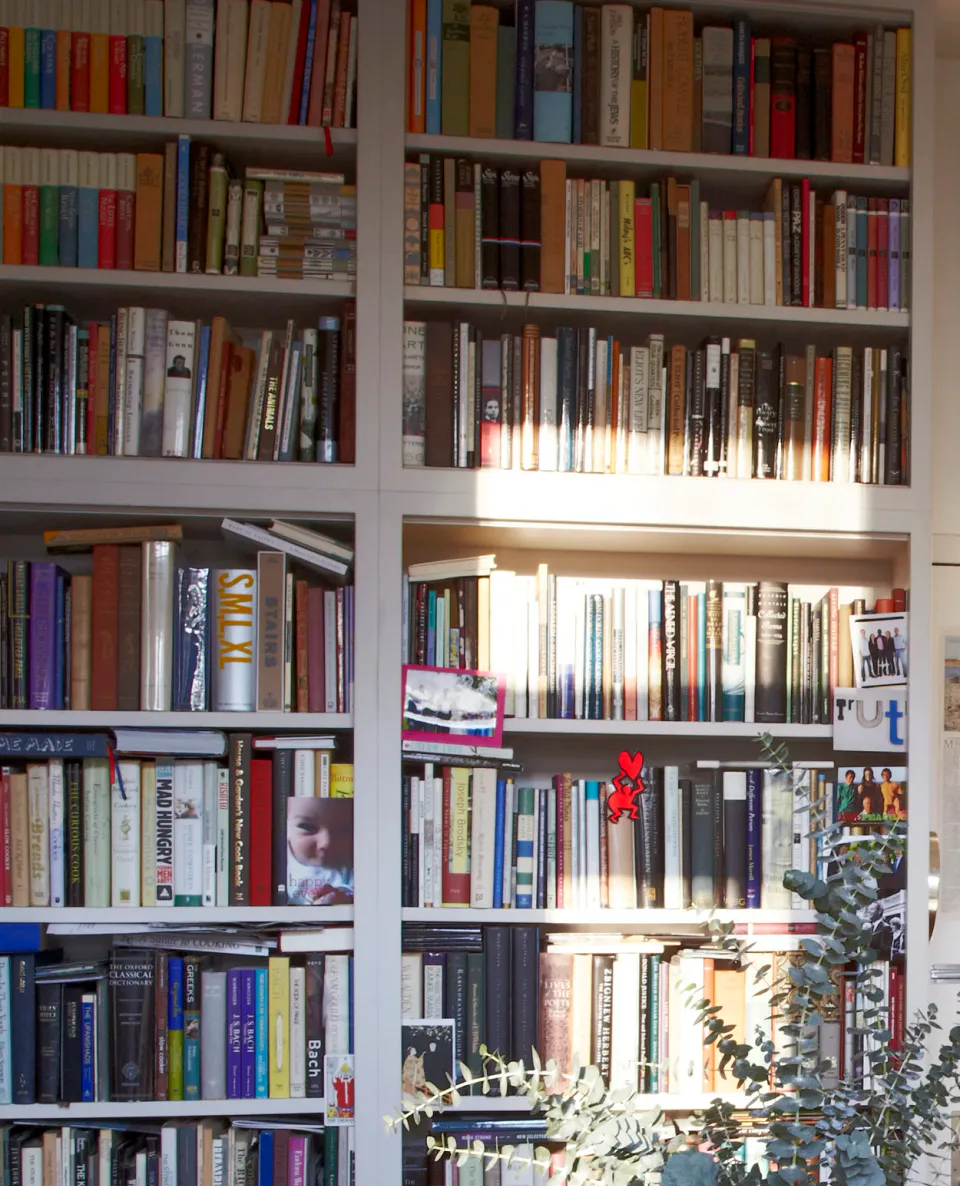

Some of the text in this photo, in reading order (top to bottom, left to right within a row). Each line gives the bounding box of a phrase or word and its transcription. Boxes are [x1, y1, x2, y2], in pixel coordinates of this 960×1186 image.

[191, 45, 207, 113] LERMAN
[608, 46, 620, 126] HISTORY JEWS
[792, 211, 802, 233] PAZ
[127, 369, 136, 409] Swimming
[264, 376, 280, 431] THE ANIMALS
[635, 350, 645, 430] ELIOT'S NEW LIFE
[673, 394, 681, 431] Collected
[665, 583, 676, 604] THE
[216, 574, 255, 670] S,M,L,XL
[264, 596, 279, 668] STAIRS
[758, 611, 787, 621] Collected
[761, 623, 781, 632] Poems
[665, 641, 675, 670] VIRGIL
[837, 699, 908, 747] TrUt
[24, 736, 74, 754] MADE
[219, 782, 229, 810] RISOTTO
[235, 740, 245, 888] House Garden's New Cook Book
[70, 782, 80, 884] THE CURIOUS COOK
[156, 780, 173, 865] MAD HUNGRY
[456, 782, 467, 858] Joseph Brodsky
[32, 819, 44, 880] Breads
[290, 872, 332, 890] happy
[193, 938, 239, 949] COOKING
[108, 971, 153, 979] CLASSICAL
[186, 965, 195, 1003] GREEKS
[329, 959, 340, 990] GLENN
[426, 967, 434, 1018] RAINER MARIA
[402, 983, 412, 1013] AUDEN
[456, 968, 464, 1027] RABINDRANATH
[83, 1006, 92, 1065] THE UPANISHADS
[232, 1029, 240, 1053] BACH
[247, 1029, 255, 1053] BACH
[601, 969, 612, 1077] ZBIGNIEW HERBERT
[308, 1040, 323, 1078] Bach
[11, 1147, 19, 1164] JUST
[76, 1164, 86, 1179] THE
[236, 1149, 246, 1164] The
[293, 1150, 303, 1175] Eudora
[236, 1169, 246, 1186] RIO
